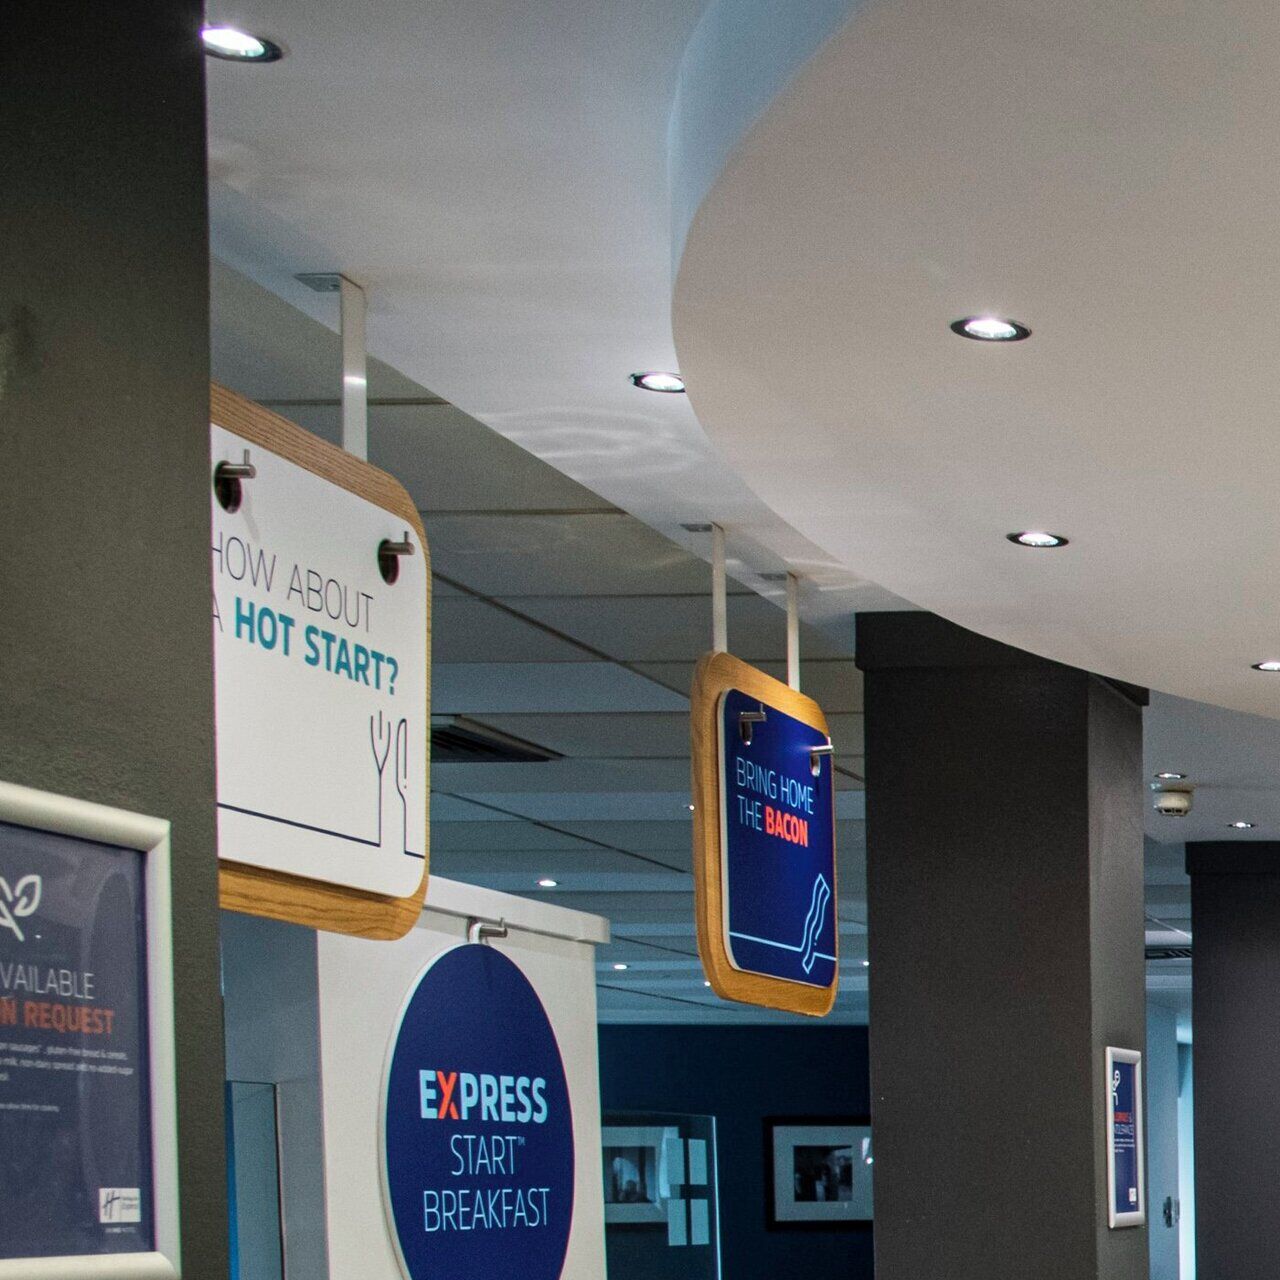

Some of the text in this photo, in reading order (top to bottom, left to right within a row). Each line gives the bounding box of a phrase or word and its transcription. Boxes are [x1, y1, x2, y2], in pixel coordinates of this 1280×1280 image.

[287, 564, 374, 633] ABOUT
[235, 596, 296, 657] HOT
[304, 624, 399, 695] START?
[736, 756, 814, 815] BRING HOME
[737, 794, 809, 847] THE BACON
[0, 962, 95, 1000] VAILABLE
[24, 1000, 114, 1035] REQUEST
[419, 1069, 548, 1124] EXPRESS
[423, 1187, 550, 1232] BREAKFAST
